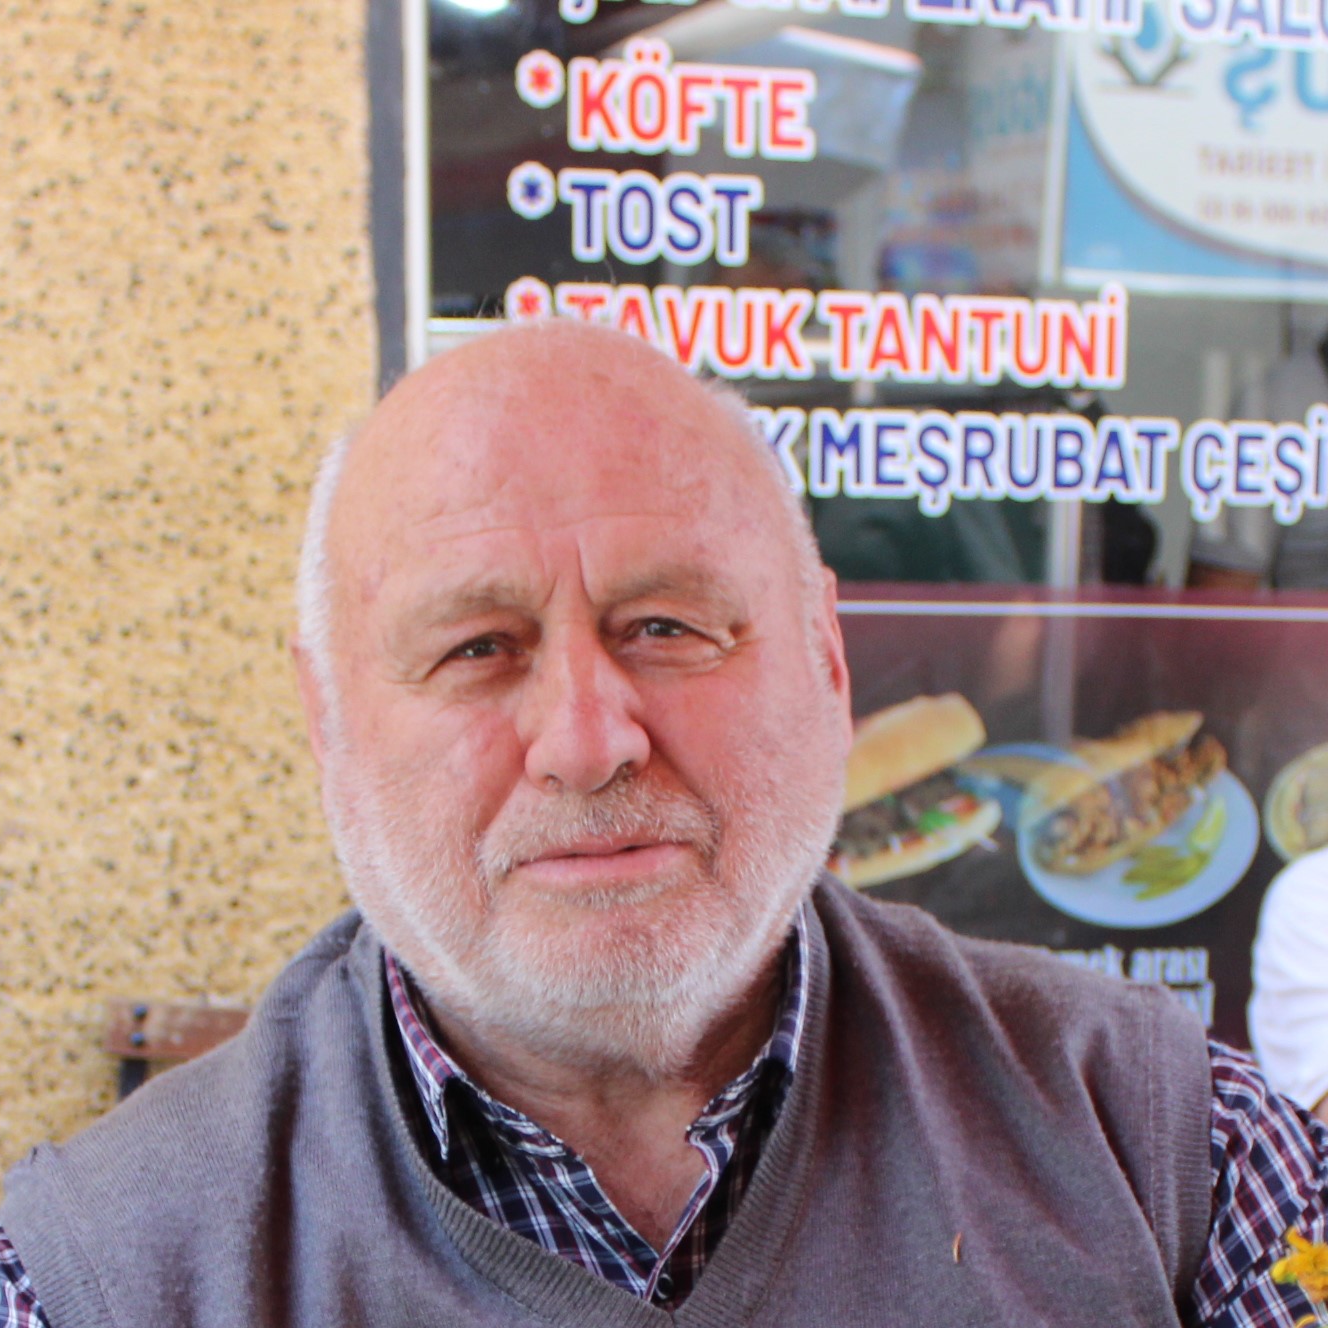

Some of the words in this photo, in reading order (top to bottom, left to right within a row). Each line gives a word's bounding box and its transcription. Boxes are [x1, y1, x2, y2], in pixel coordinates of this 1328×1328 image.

[572, 42, 812, 155] KÖFTE
[563, 176, 755, 257] TOST
[823, 290, 1122, 382] TANTUNİ
[815, 412, 1173, 510] MEŞRUBAT
